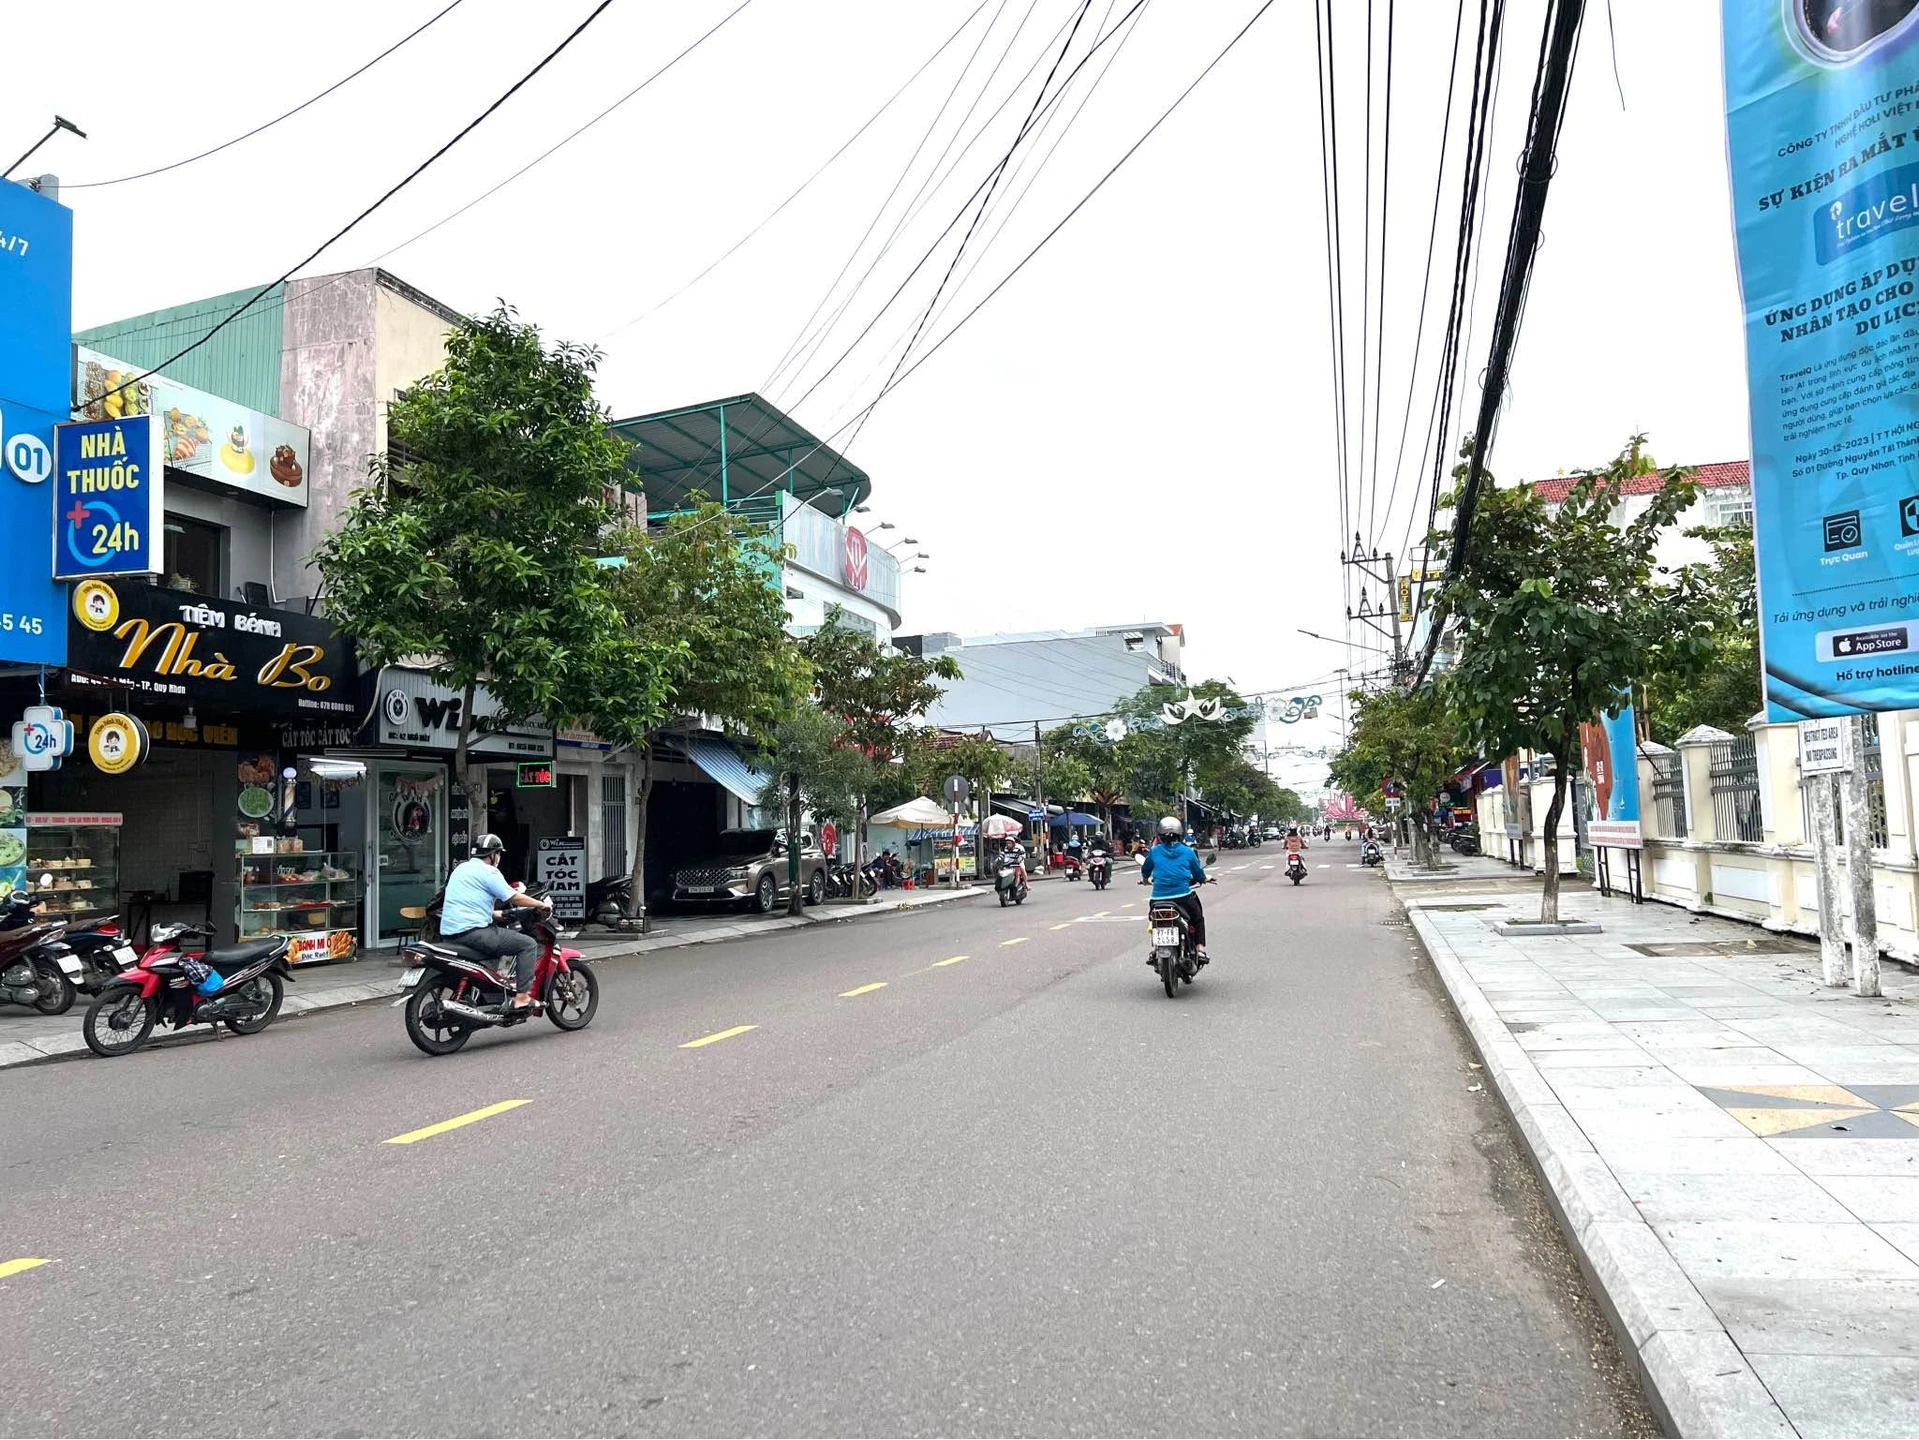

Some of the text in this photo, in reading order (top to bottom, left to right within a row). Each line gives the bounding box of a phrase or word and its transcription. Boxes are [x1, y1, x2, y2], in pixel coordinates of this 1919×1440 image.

[1778, 137, 1813, 158] CÔNG
[1814, 129, 1828, 143] TY
[1829, 114, 1853, 135] TNHH
[1873, 90, 1893, 105] TƯ
[1858, 113, 1880, 132] HOLI
[1883, 101, 1912, 118] VIỆT
[1758, 189, 1785, 212] SỰ
[1790, 169, 1835, 200] KIỆN
[1838, 155, 1859, 178] RA
[1861, 131, 1908, 164] MẮT
[1764, 302, 1807, 327] ỨNG
[1810, 280, 1857, 313] DỤNG
[1861, 269, 1883, 291] ÁP
[1780, 281, 1914, 343] NHÂN TẠO CHO
[1855, 301, 1919, 336] DU LỊC
[80, 425, 127, 459] NHÀ
[14, 442, 44, 476] 01
[1851, 465, 1870, 477] Quy
[66, 456, 140, 494] THUỐC
[91, 521, 140, 554] 24h
[1841, 550, 1869, 561] Quan
[0, 613, 43, 635] 5 45
[178, 603, 226, 629] TIỆM
[1773, 612, 1789, 624] Tải
[1792, 609, 1815, 622] ứng
[1817, 604, 1847, 618] dụng
[1850, 601, 1866, 612] và
[113, 618, 332, 692] Nhà Bo
[1855, 638, 1902, 652] App Store
[153, 682, 168, 694] Quy
[1855, 669, 1875, 681] trợ
[34, 733, 57, 749] 24h
[282, 722, 299, 748] CẮT
[300, 725, 316, 747] TÓC
[335, 722, 351, 745] TÓC
[545, 851, 578, 867] CẮT
[545, 868, 578, 880] TÓC
